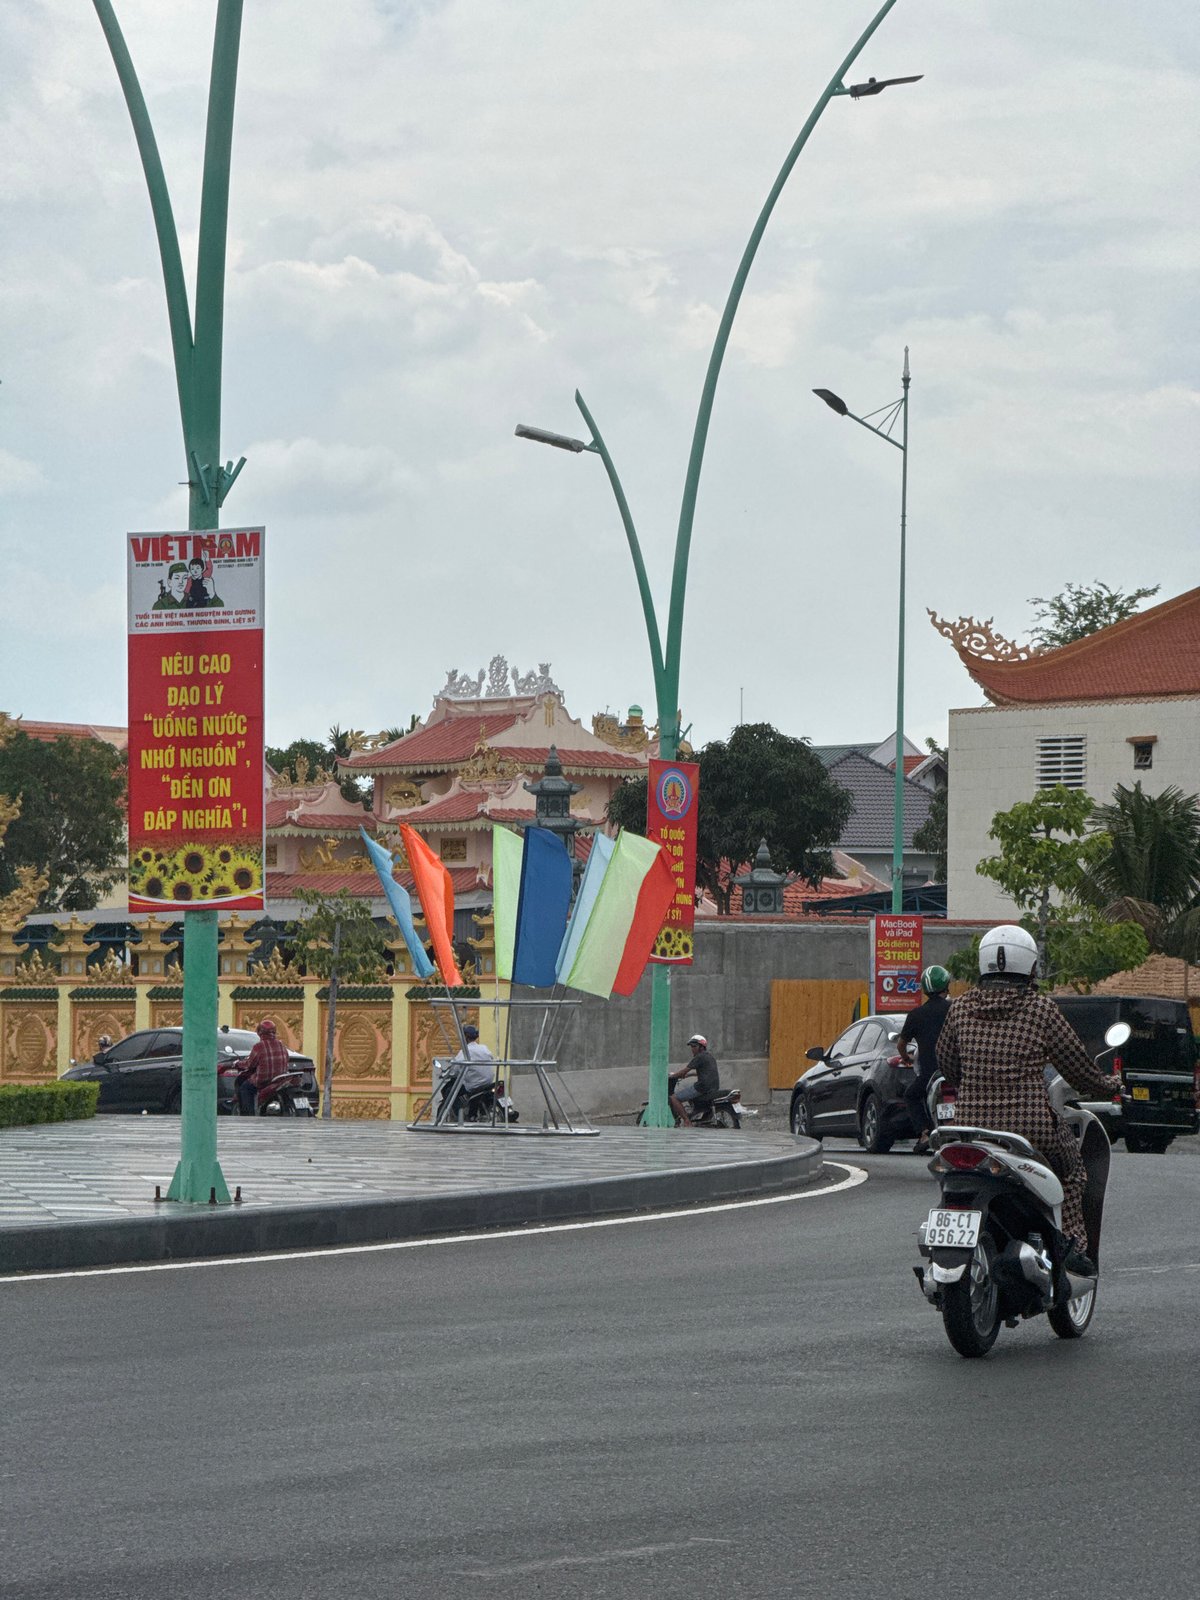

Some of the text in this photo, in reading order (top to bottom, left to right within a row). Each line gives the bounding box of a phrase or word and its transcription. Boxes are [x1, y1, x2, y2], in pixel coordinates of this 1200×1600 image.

[161, 651, 231, 676] NÊU CAO
[167, 680, 225, 711] ĐẠO LÝ
[202, 711, 248, 736] NƯỚC
[140, 744, 175, 769] NHỚ
[208, 775, 232, 798] ƠN
[143, 806, 178, 831] ĐÁP
[880, 919, 918, 929] MacBook
[896, 929, 913, 937] iPad
[935, 1212, 972, 1229] 86-C1
[928, 1228, 976, 1246] 956.22
